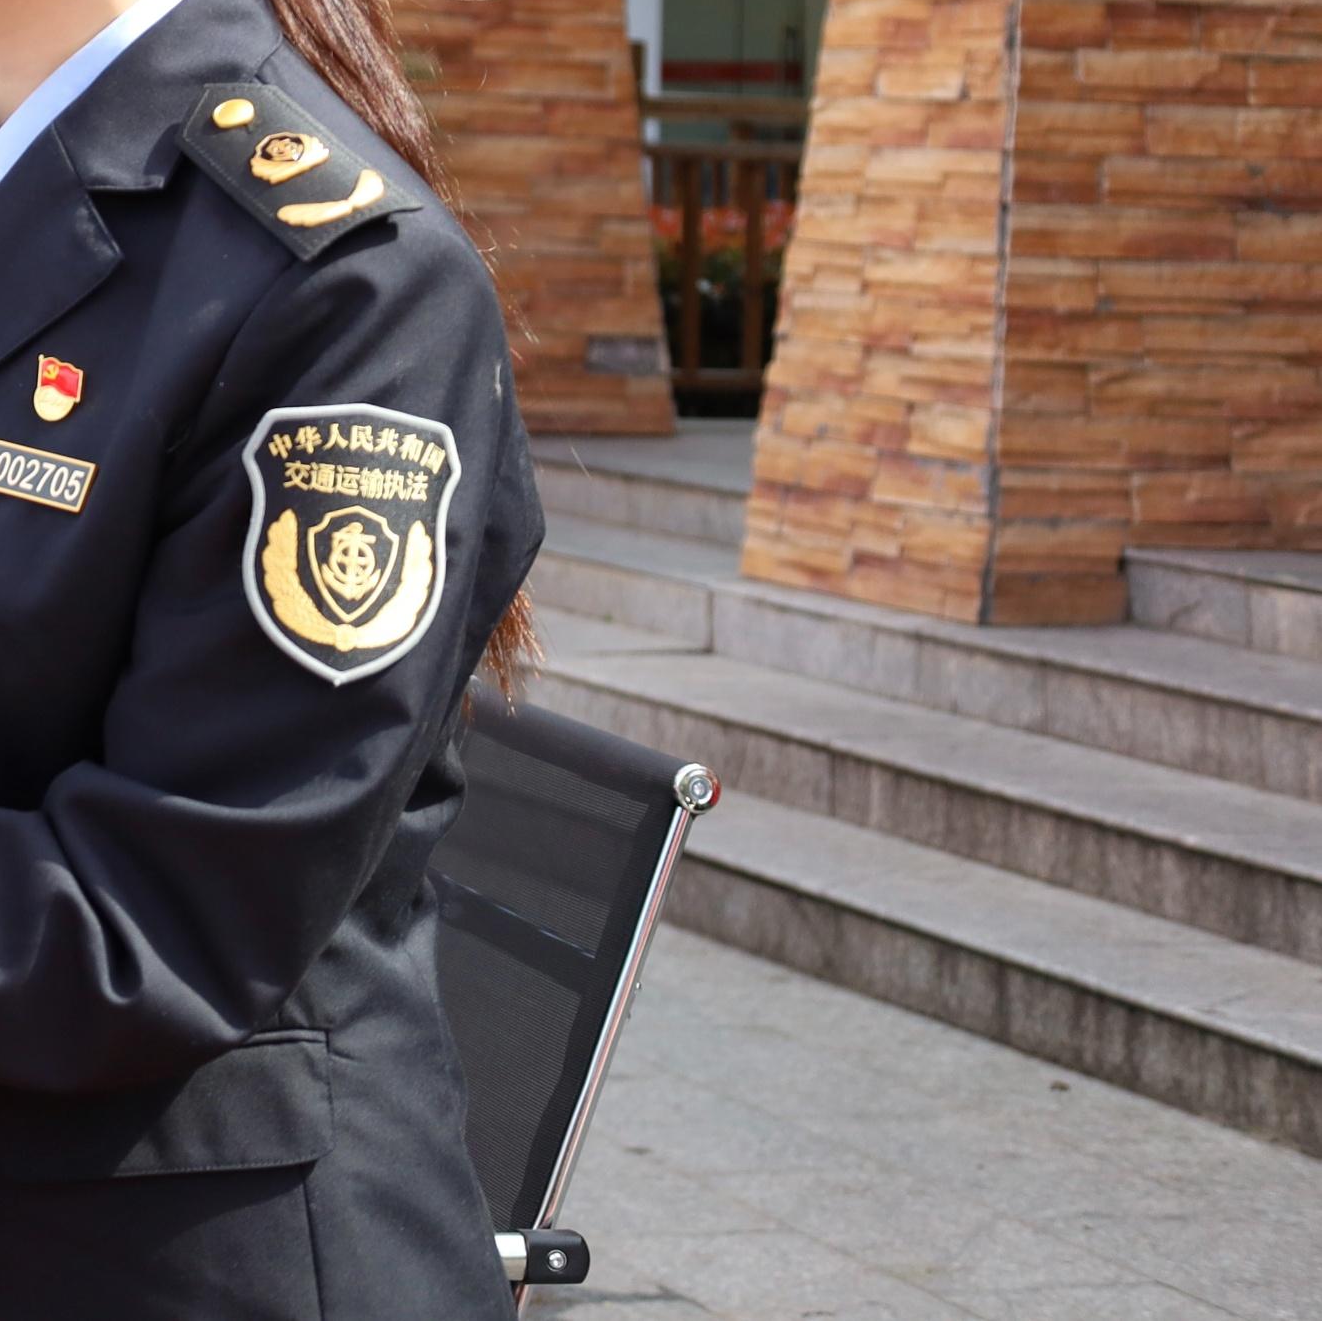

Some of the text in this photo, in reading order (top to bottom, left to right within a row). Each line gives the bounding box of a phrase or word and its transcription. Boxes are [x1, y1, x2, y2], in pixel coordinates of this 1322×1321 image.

[268, 422, 446, 475] 中华人民共和国
[283, 460, 430, 503] 交通运输执法
